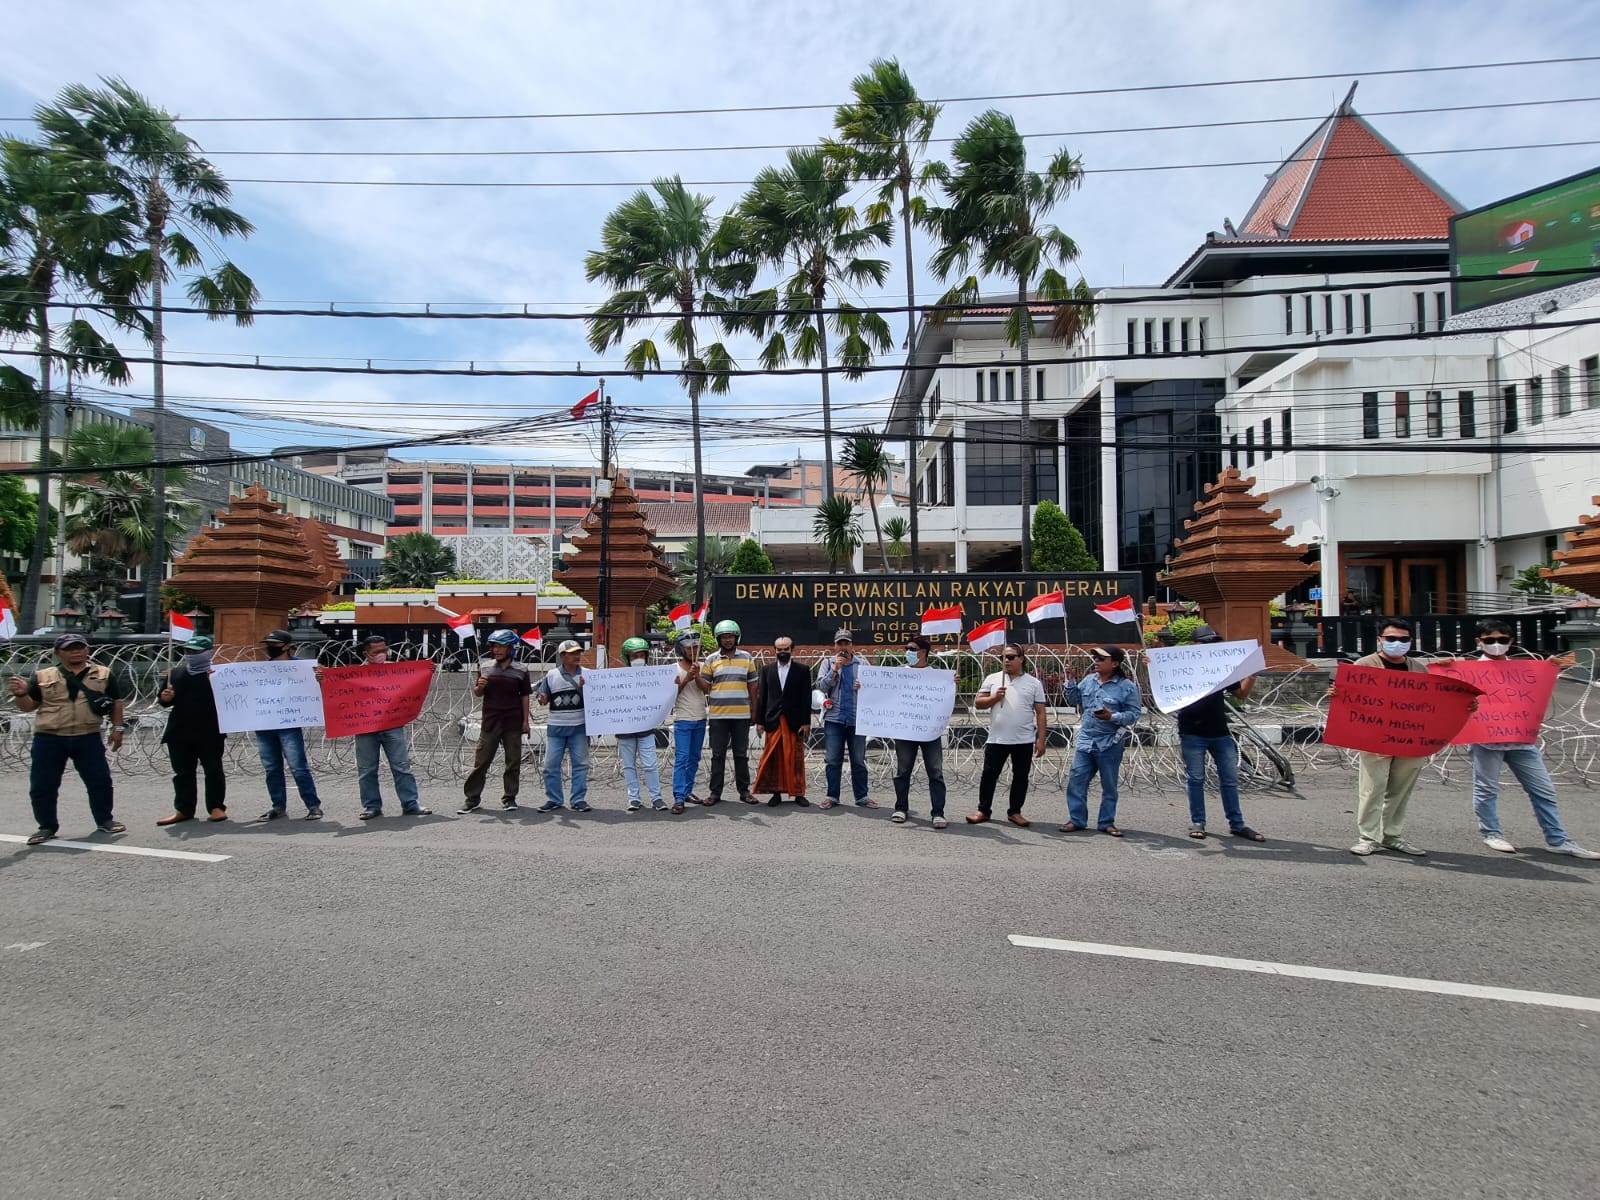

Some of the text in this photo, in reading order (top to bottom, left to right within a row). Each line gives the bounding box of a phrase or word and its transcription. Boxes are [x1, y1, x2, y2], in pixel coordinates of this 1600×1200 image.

[736, 581, 1118, 598] DEWAN PERWAKILAN RAKYAT DAERAH
[814, 602, 904, 617] PROVINSI
[978, 601, 1024, 616] TIMU
[874, 632, 966, 642] SURBAY
[1155, 648, 1246, 664] BERANTAS KORUPSI
[1159, 670, 1166, 679] DI
[1347, 672, 1377, 686] KPK
[1388, 675, 1428, 690] HARUS
[1446, 669, 1537, 685] DUKUNG
[223, 694, 249, 712] KPK
[1343, 691, 1436, 714] KASUS KORUPSI
[1486, 688, 1536, 704] KPK
[277, 708, 301, 716] HIBAH
[1350, 711, 1425, 732] DANA HIBAH
[1382, 734, 1413, 745] JAWA
[1488, 726, 1519, 737] DANA
